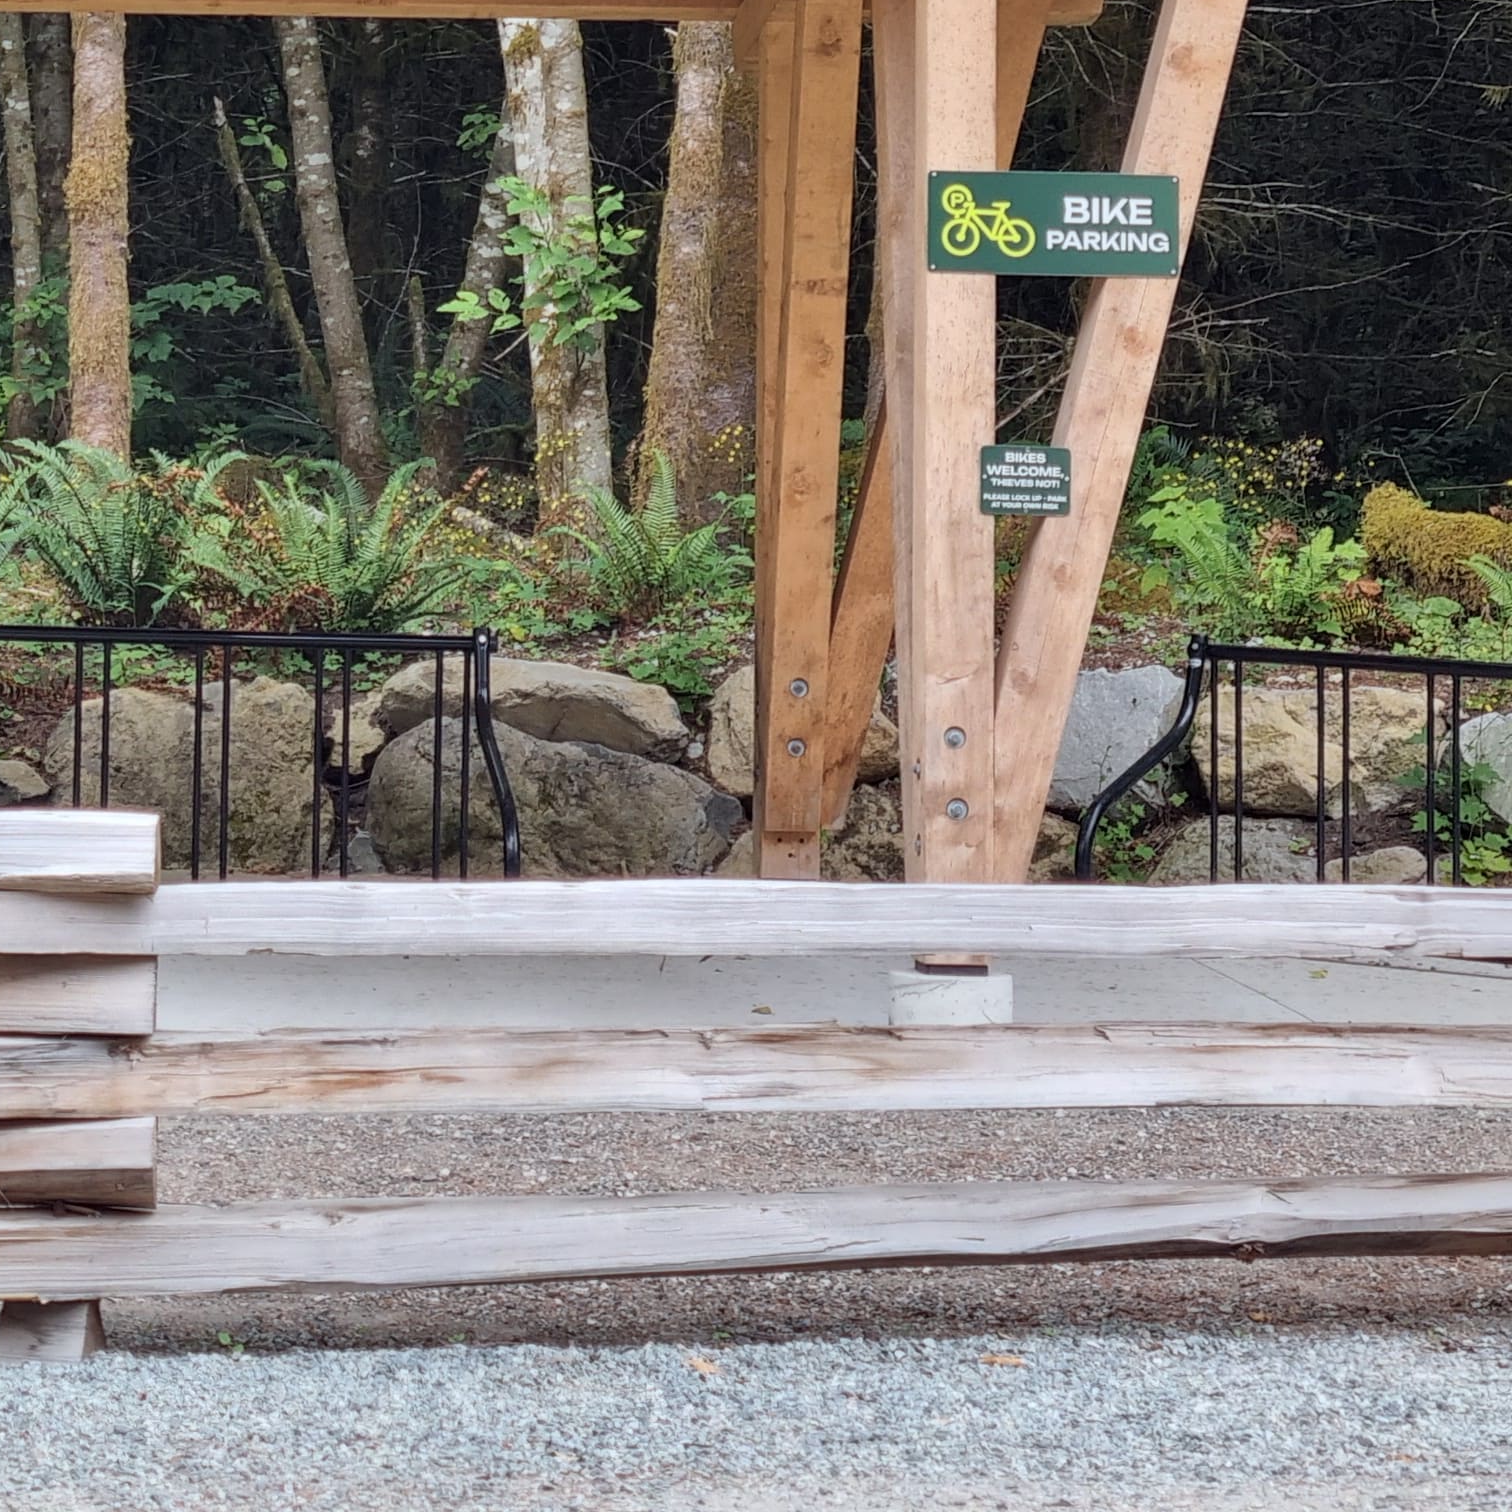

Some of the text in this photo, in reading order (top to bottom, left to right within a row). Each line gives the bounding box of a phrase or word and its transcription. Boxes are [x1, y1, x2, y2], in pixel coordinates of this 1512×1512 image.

[1063, 196, 1153, 226] BIKE
[1046, 230, 1170, 253] PARKING
[1005, 452, 1046, 464] BIKES
[986, 465, 1065, 479] WELCOME,
[990, 478, 1034, 488] THIEVES
